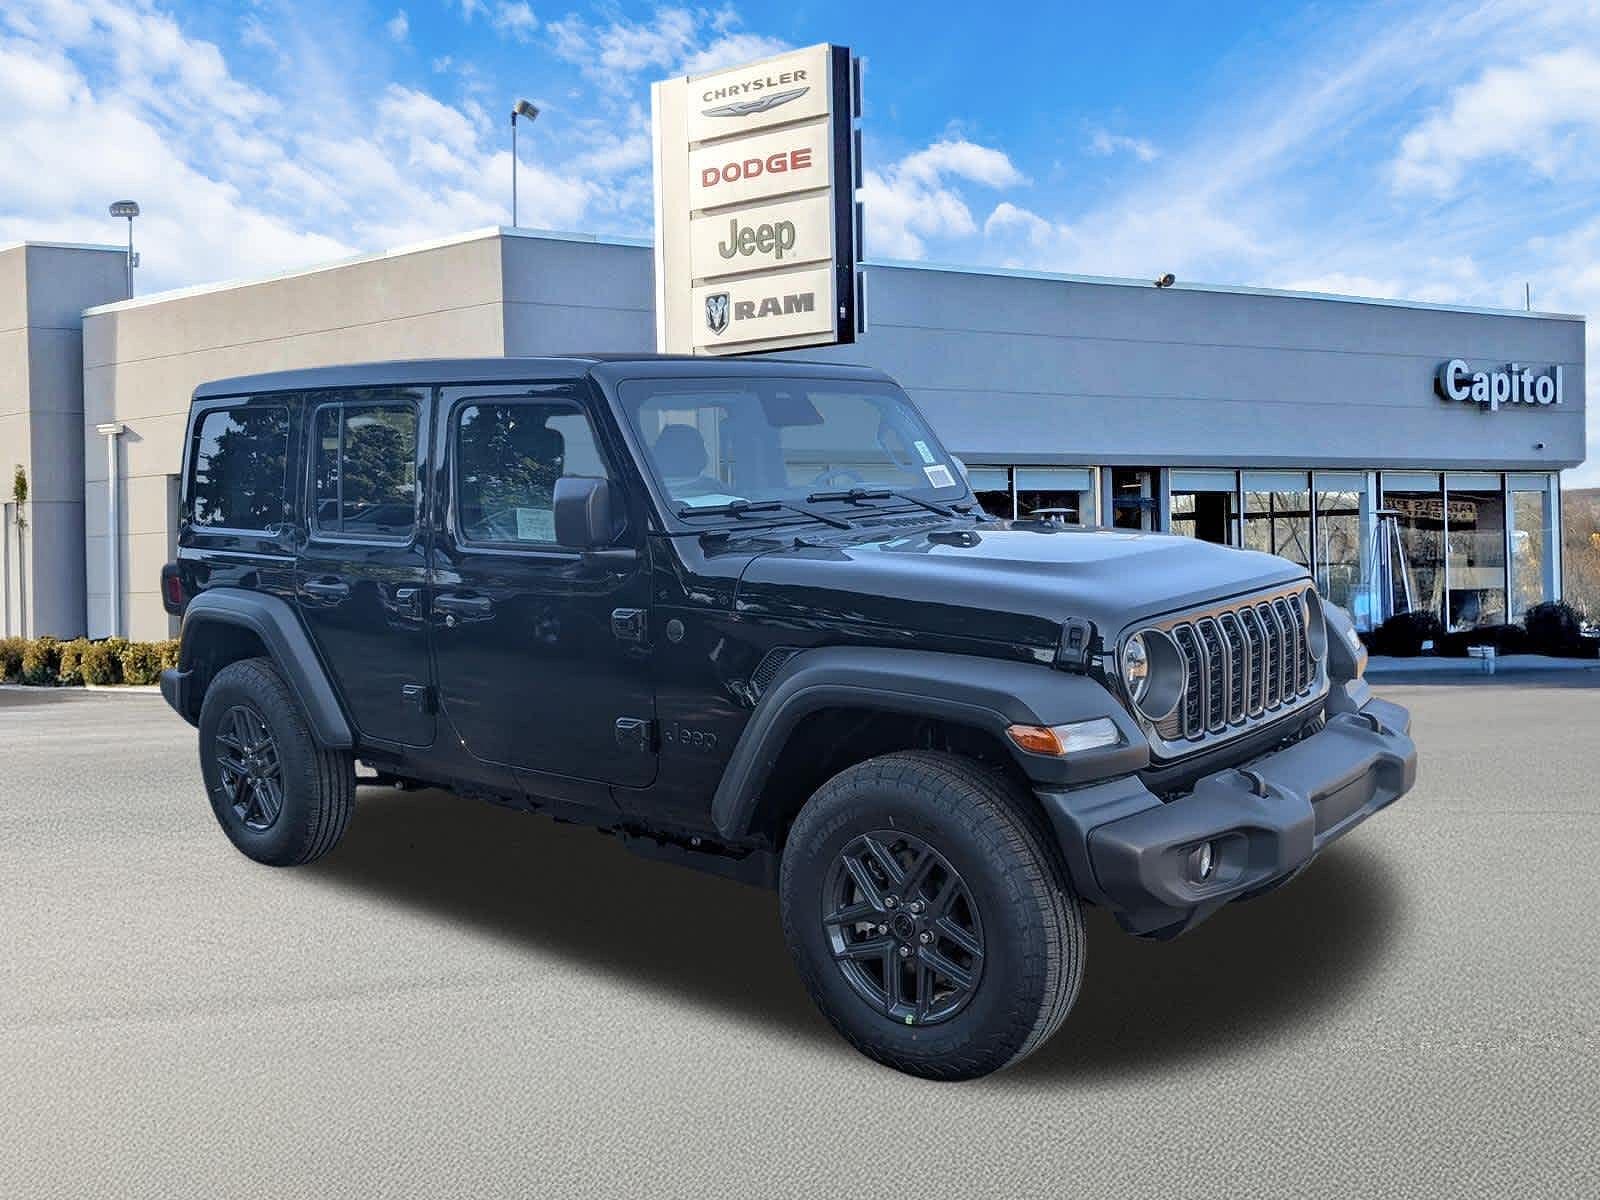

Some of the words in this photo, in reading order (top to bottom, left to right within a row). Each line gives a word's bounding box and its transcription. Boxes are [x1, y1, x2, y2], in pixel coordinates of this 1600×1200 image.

[702, 70, 807, 102] CHRYSLER
[702, 148, 812, 187] DODGE
[718, 219, 796, 259] Jeep
[734, 292, 815, 321] RAM
[1446, 359, 1563, 411] Capitol
[665, 722, 717, 752] Jeep
